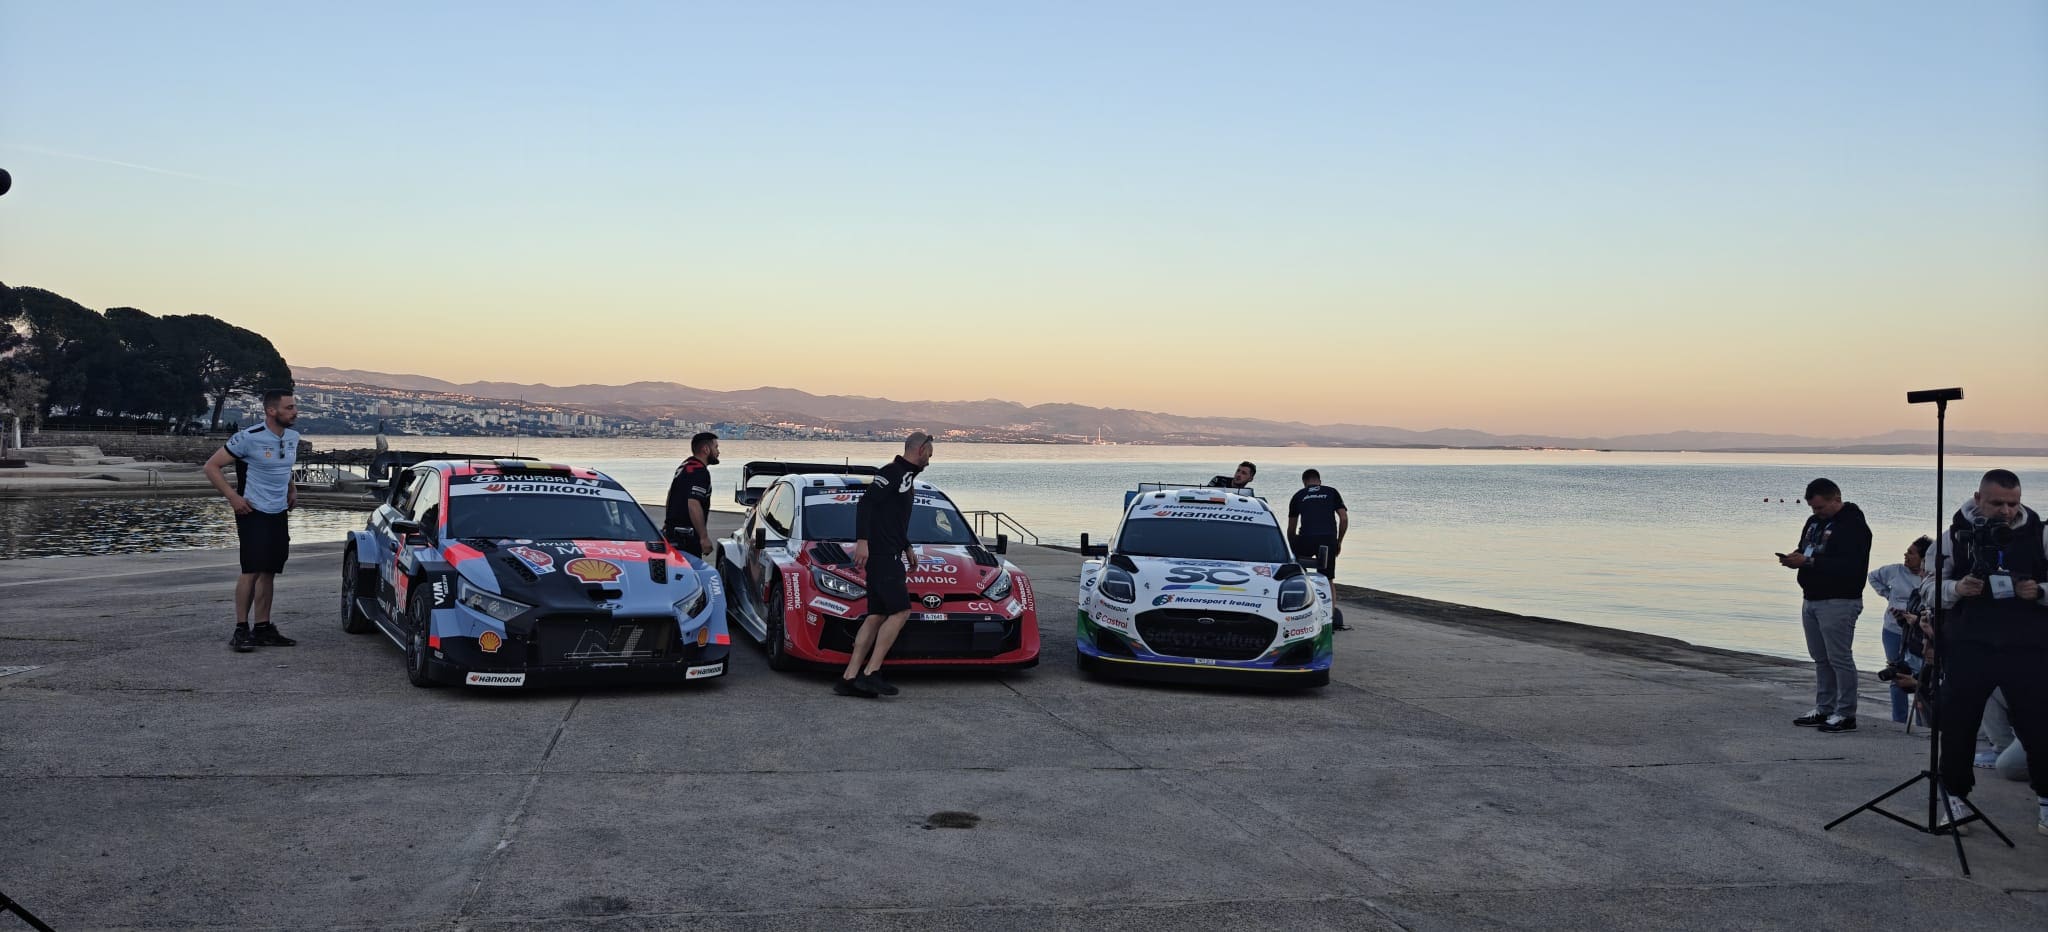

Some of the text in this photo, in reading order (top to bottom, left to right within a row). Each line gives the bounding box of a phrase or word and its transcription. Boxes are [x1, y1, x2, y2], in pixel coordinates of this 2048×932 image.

[504, 475, 568, 483] HYUNDAI
[1163, 504, 1264, 516] Motorsport Ireland
[556, 546, 642, 558] MOBIS
[1164, 566, 1251, 586] SC
[791, 572, 803, 609] Panasonic
[1174, 596, 1263, 609] Motorsport Ireland
[1101, 613, 1129, 629] Castrol
